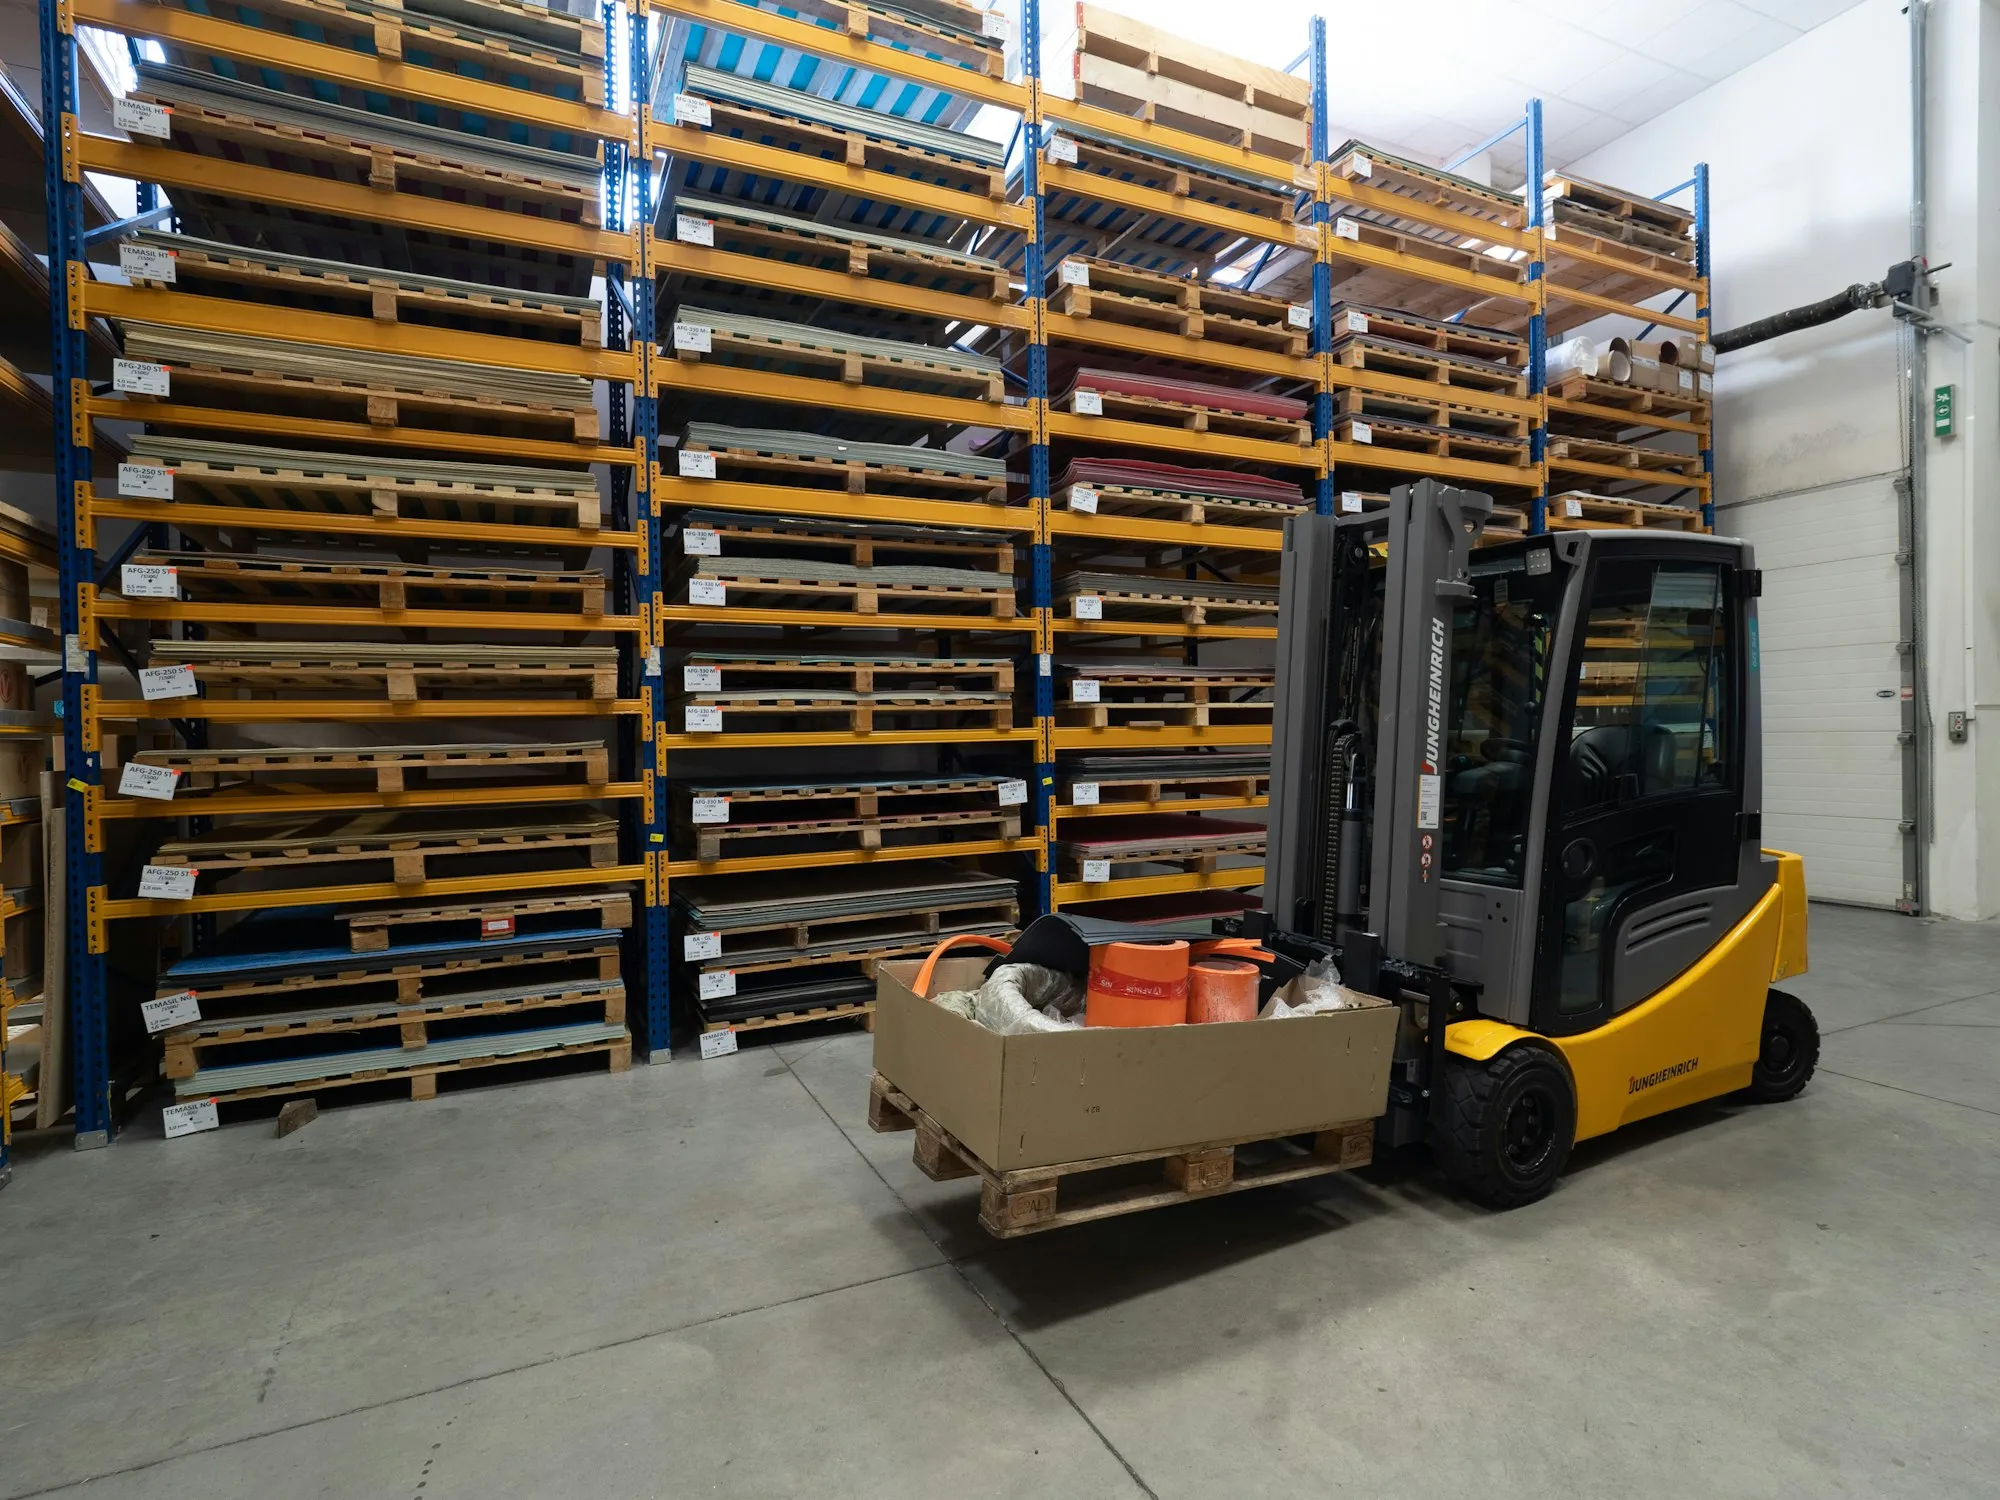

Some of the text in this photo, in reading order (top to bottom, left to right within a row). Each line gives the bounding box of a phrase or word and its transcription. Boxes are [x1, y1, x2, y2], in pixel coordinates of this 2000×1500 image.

[118, 100, 152, 112] TEMASIL
[123, 247, 156, 258] TEMASIL
[118, 362, 152, 371] AFG-250
[122, 466, 156, 475] AFG-250
[145, 669, 176, 677] AFG-250
[1425, 617, 1445, 775] JUNGHEINRICH
[129, 766, 162, 776] AFG-250
[145, 999, 178, 1011] TEMASIL
[1628, 1056, 1699, 1095] JUNGHEINRICH
[166, 1104, 199, 1116] TEMASIL
